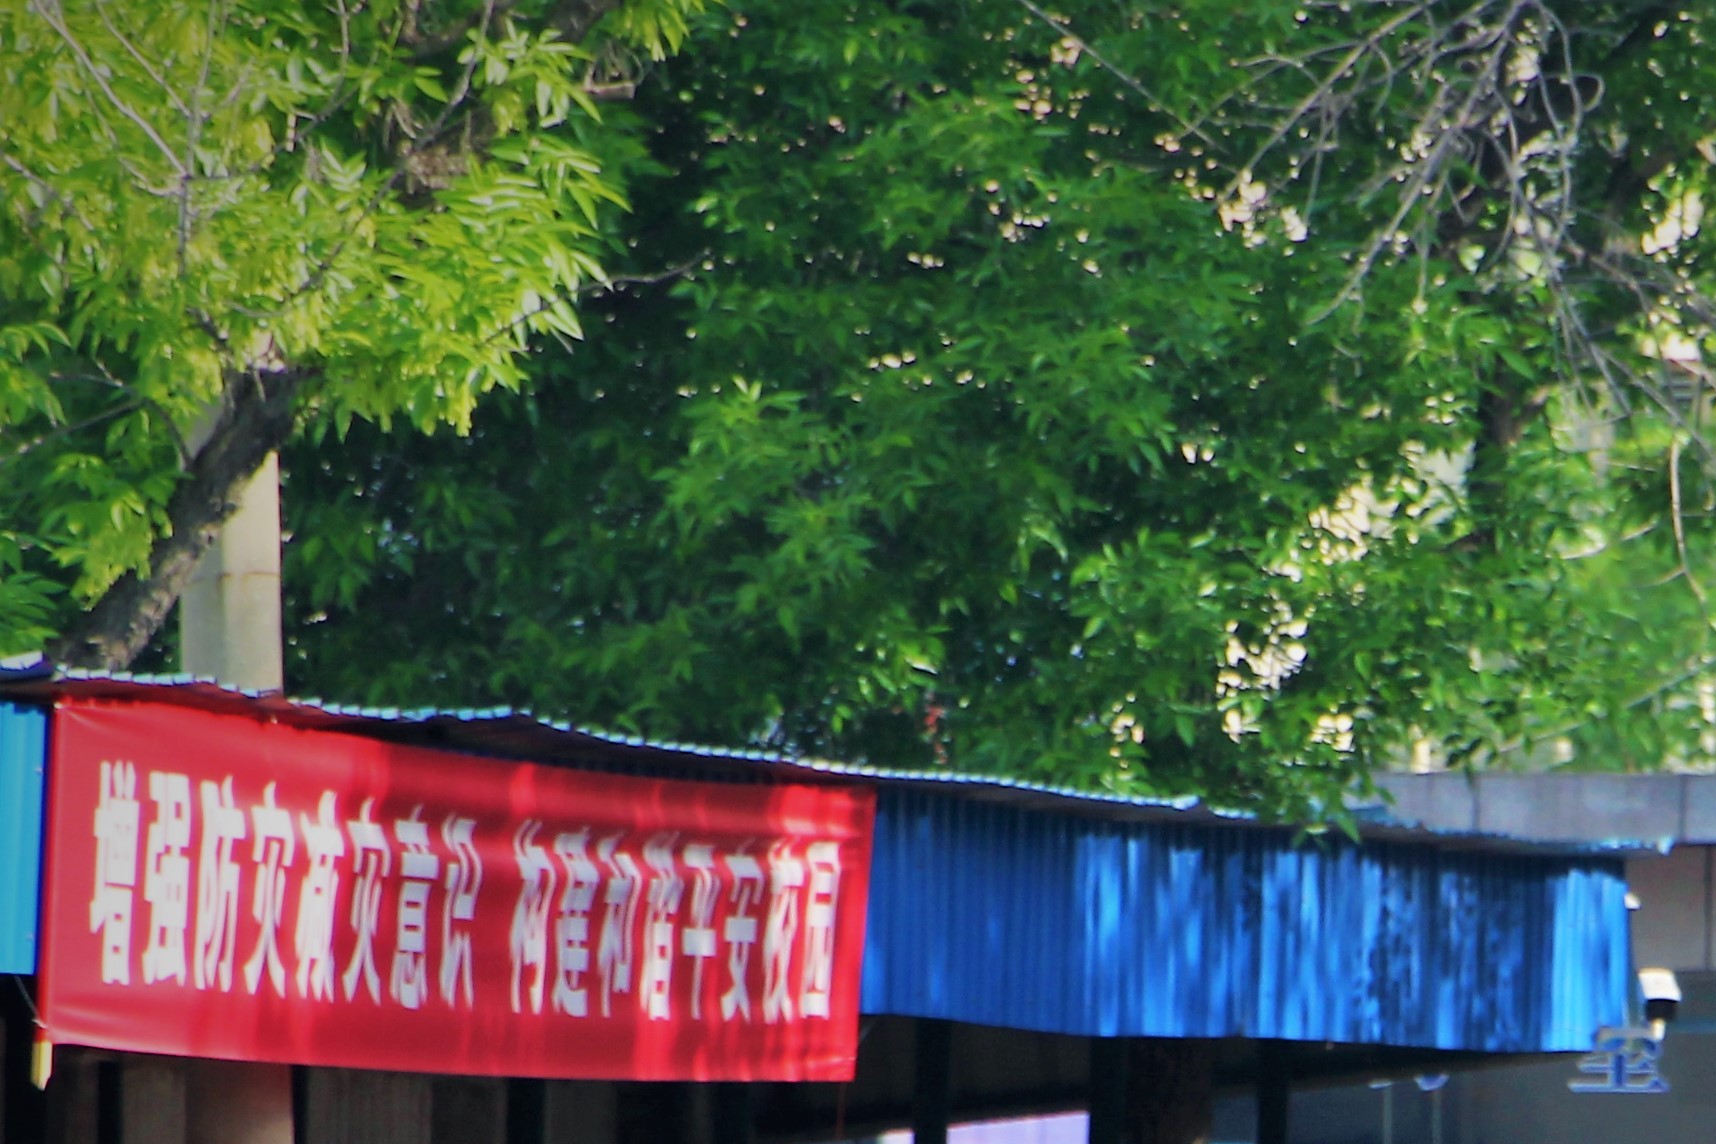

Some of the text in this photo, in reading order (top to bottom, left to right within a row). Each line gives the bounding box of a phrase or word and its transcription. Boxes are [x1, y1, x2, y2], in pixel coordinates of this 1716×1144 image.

[90, 760, 842, 1025] 增强防灾减灾意识 构建和谐平安校园
